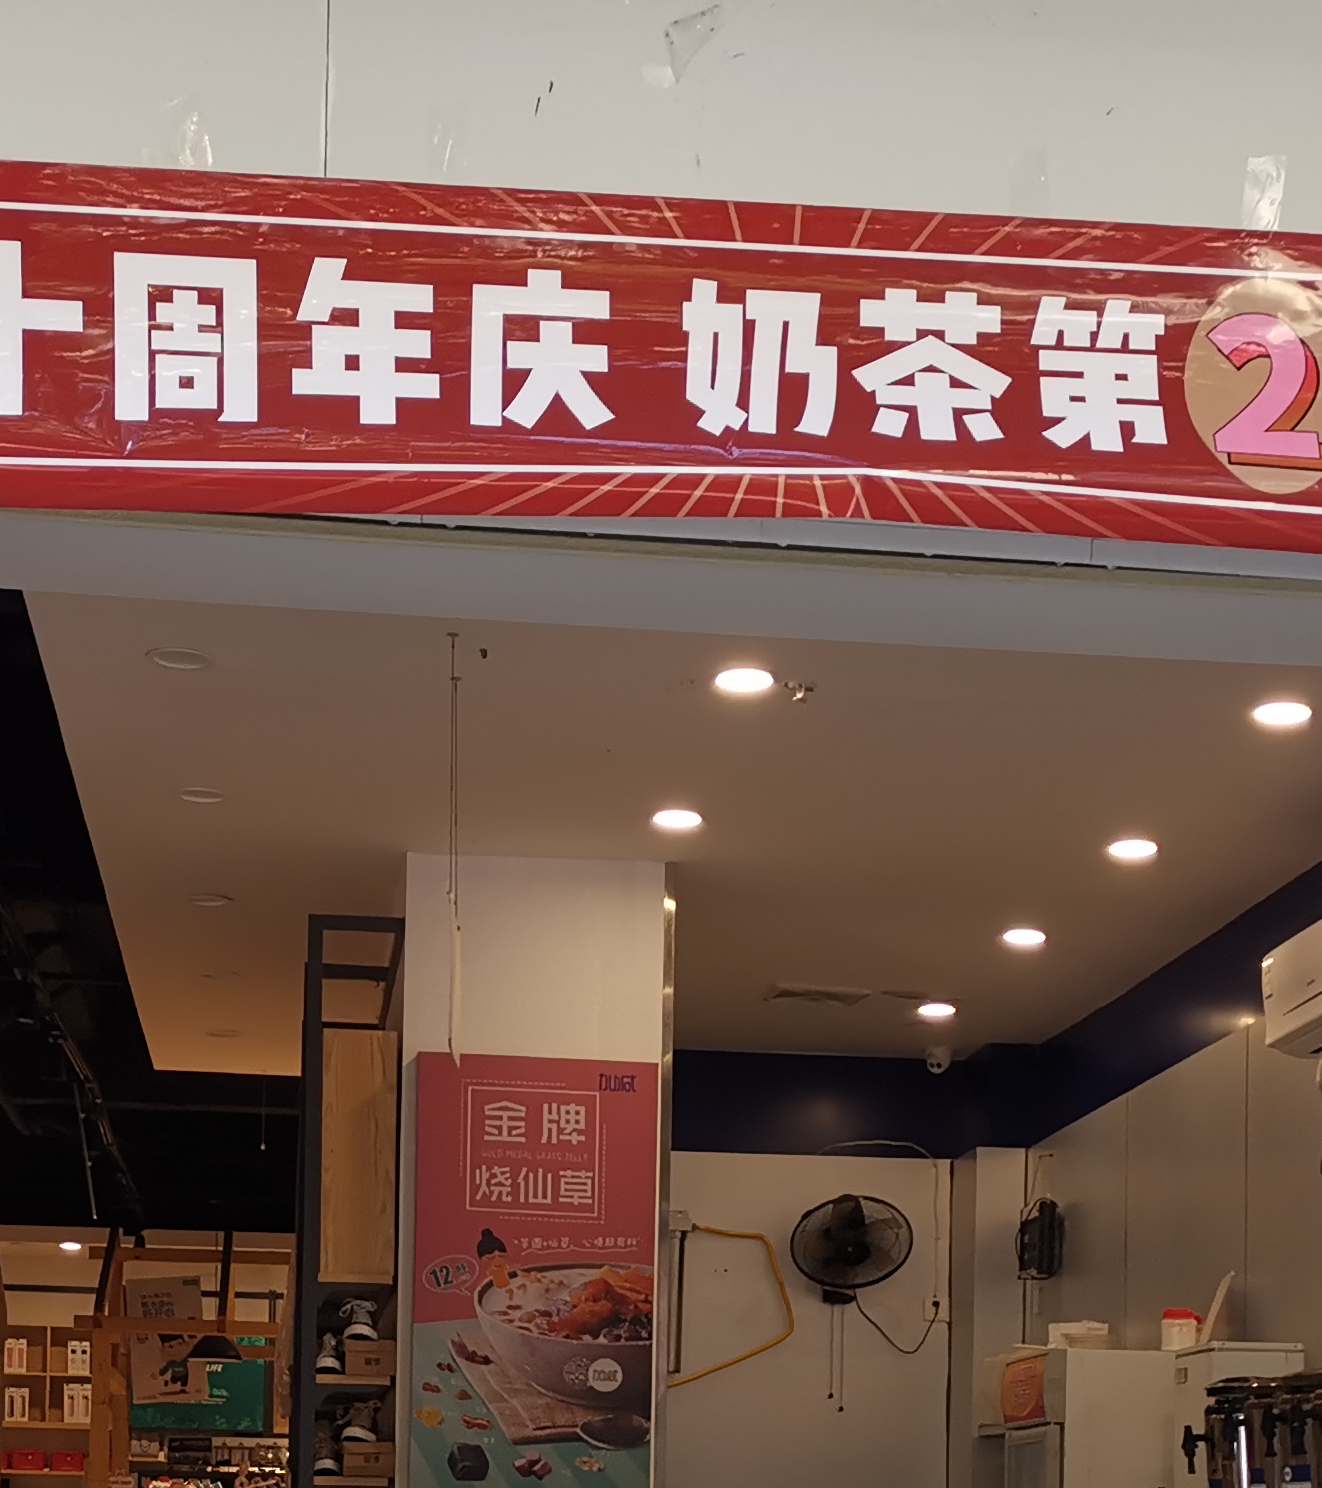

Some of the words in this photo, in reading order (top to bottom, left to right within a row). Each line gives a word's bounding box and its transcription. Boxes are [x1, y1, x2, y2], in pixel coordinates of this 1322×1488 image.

[483, 1100, 587, 1145] 金牌
[475, 1165, 594, 1206] 烧仙草
[429, 1264, 454, 1288] 12
